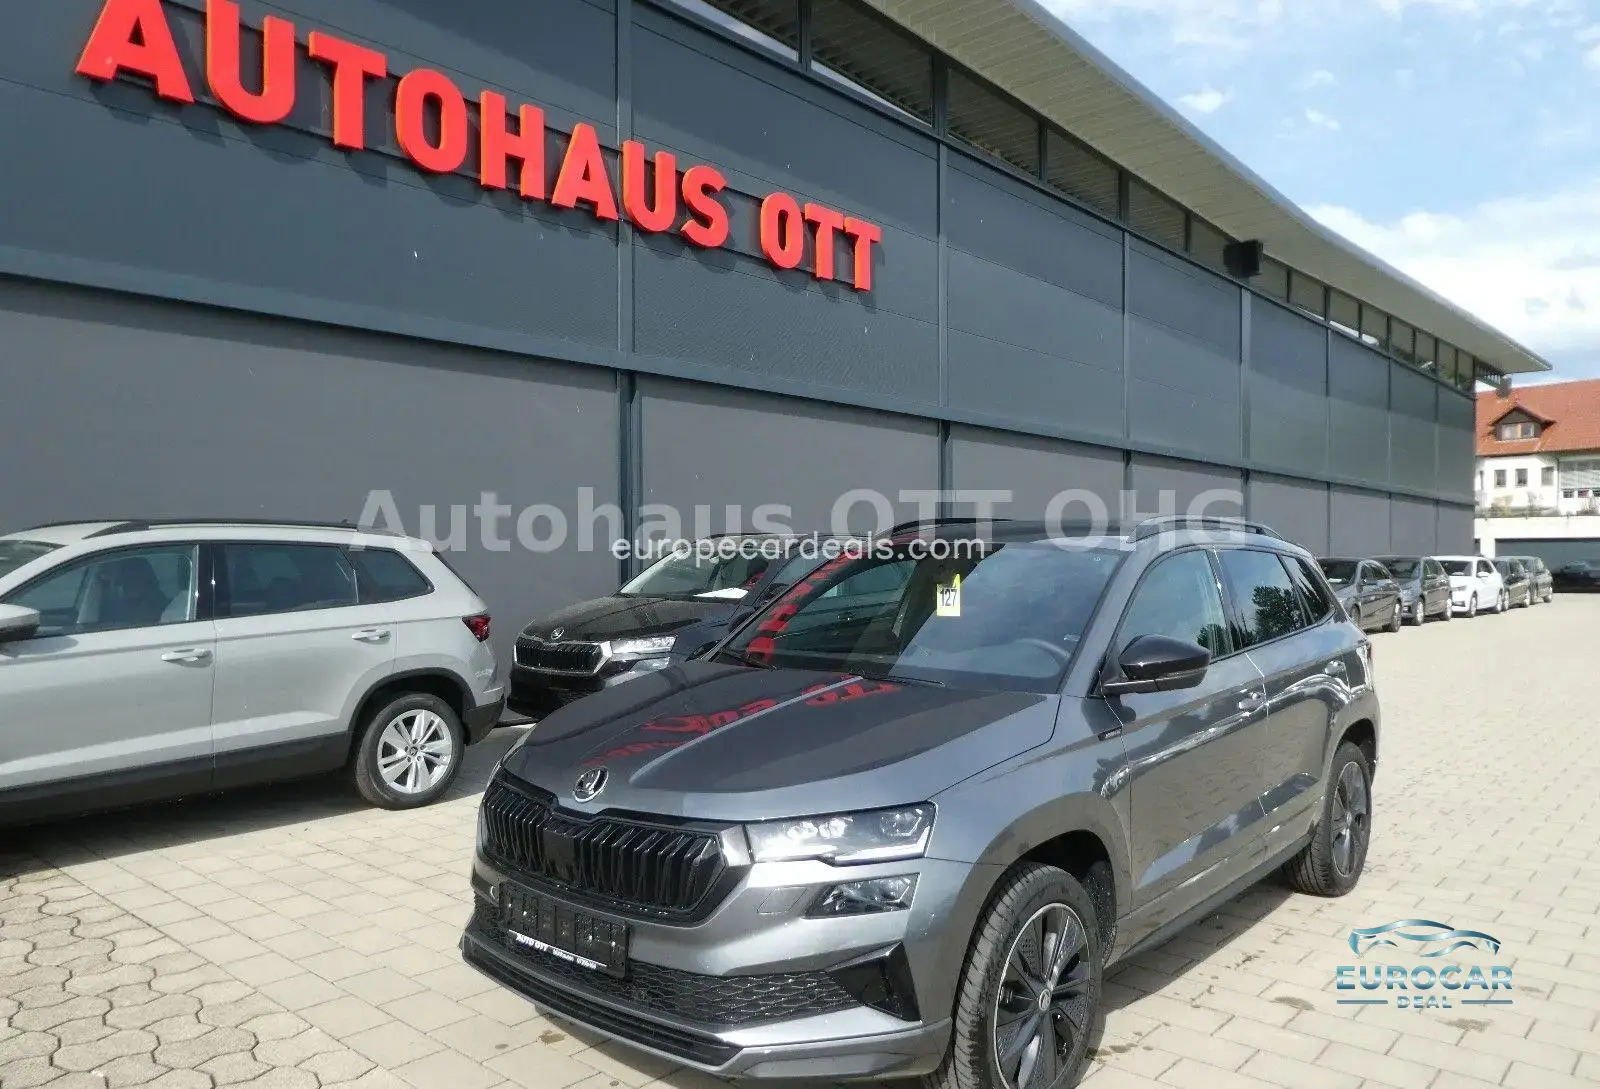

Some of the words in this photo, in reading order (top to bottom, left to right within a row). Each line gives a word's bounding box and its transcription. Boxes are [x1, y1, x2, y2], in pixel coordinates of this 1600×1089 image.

[75, 0, 729, 249] AUTOHAUS
[759, 191, 882, 292] OTT
[939, 588, 958, 607] 127
